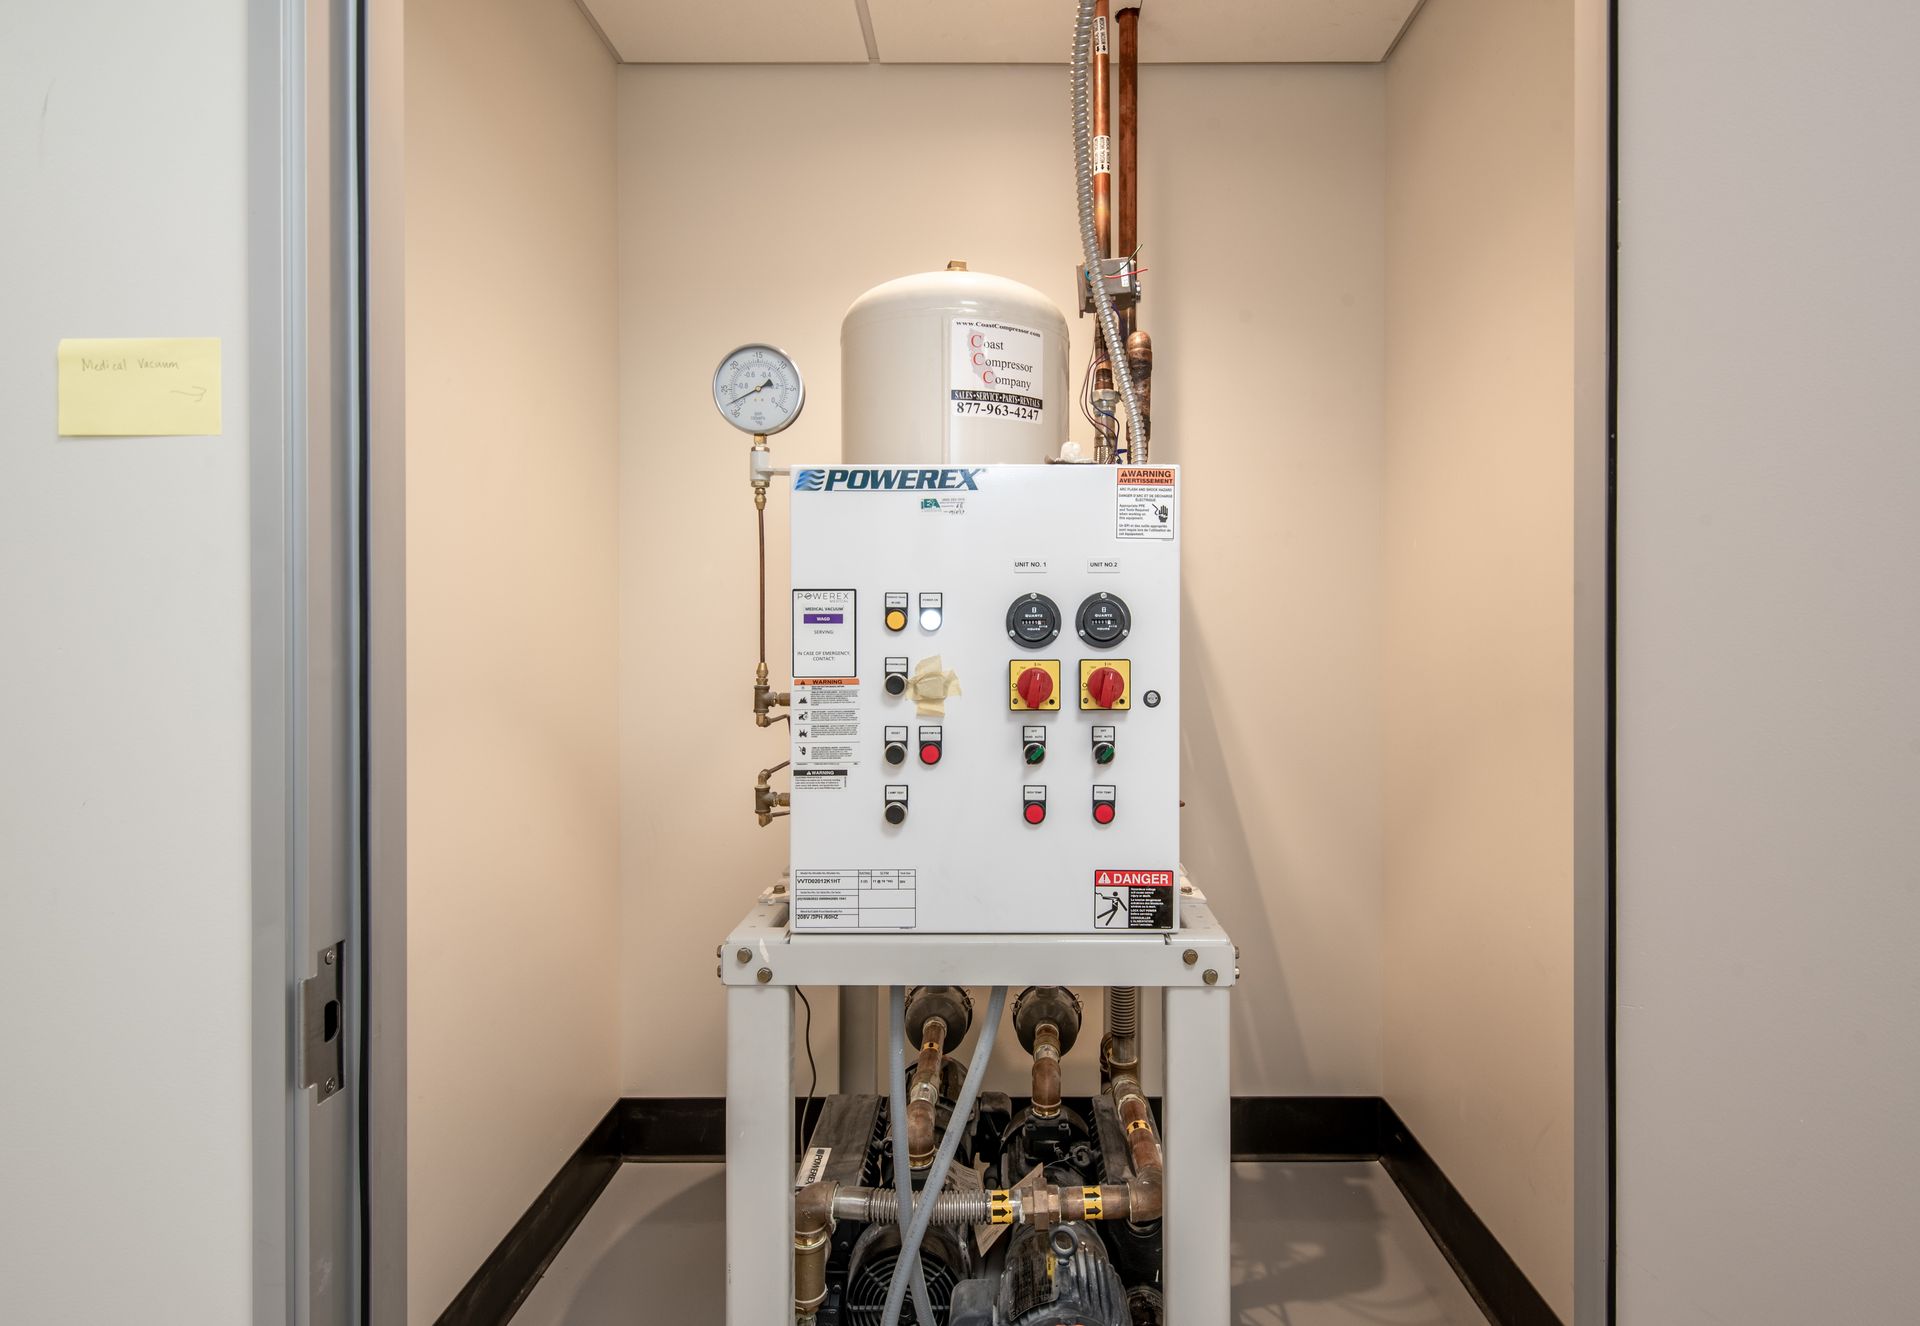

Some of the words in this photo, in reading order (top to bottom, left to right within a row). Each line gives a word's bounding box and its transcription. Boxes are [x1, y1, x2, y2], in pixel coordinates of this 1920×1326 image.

[971, 335, 1004, 350] Coast
[82, 358, 127, 372] Medical
[138, 358, 180, 370] Vacuum
[973, 353, 1033, 372] Compressor
[983, 371, 1031, 391] Company
[957, 402, 1038, 421] 877-963-4247
[825, 469, 983, 491] POWEREX
[1114, 874, 1168, 884] DANGER
